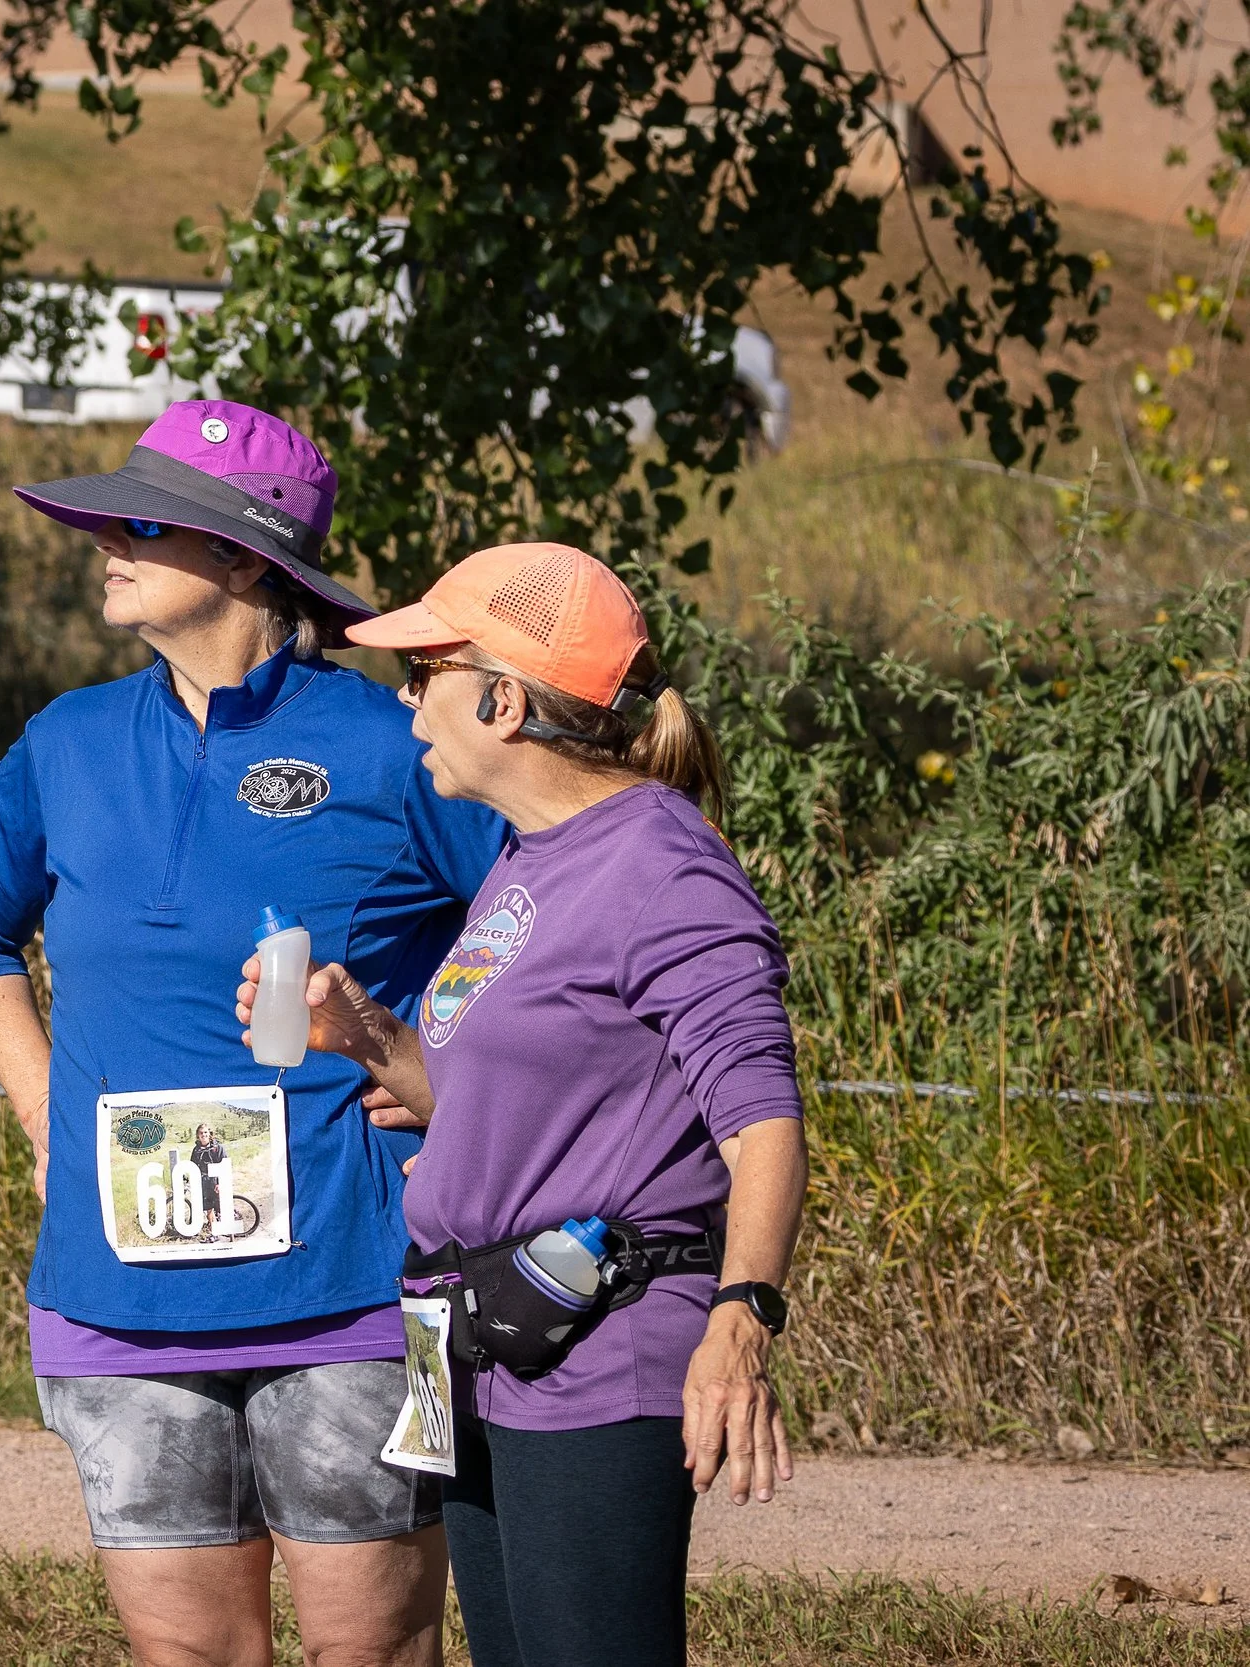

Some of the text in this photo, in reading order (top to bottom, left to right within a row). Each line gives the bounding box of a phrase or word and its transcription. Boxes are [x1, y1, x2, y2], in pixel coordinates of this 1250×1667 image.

[247, 763, 264, 771] Tom
[288, 758, 321, 772] Memorial
[473, 892, 532, 995] MARATHON
[475, 928, 504, 939] BIG
[503, 932, 515, 943] 5
[429, 1021, 452, 1041] 2017
[118, 1114, 131, 1125] Tom
[137, 1157, 244, 1239] 601
